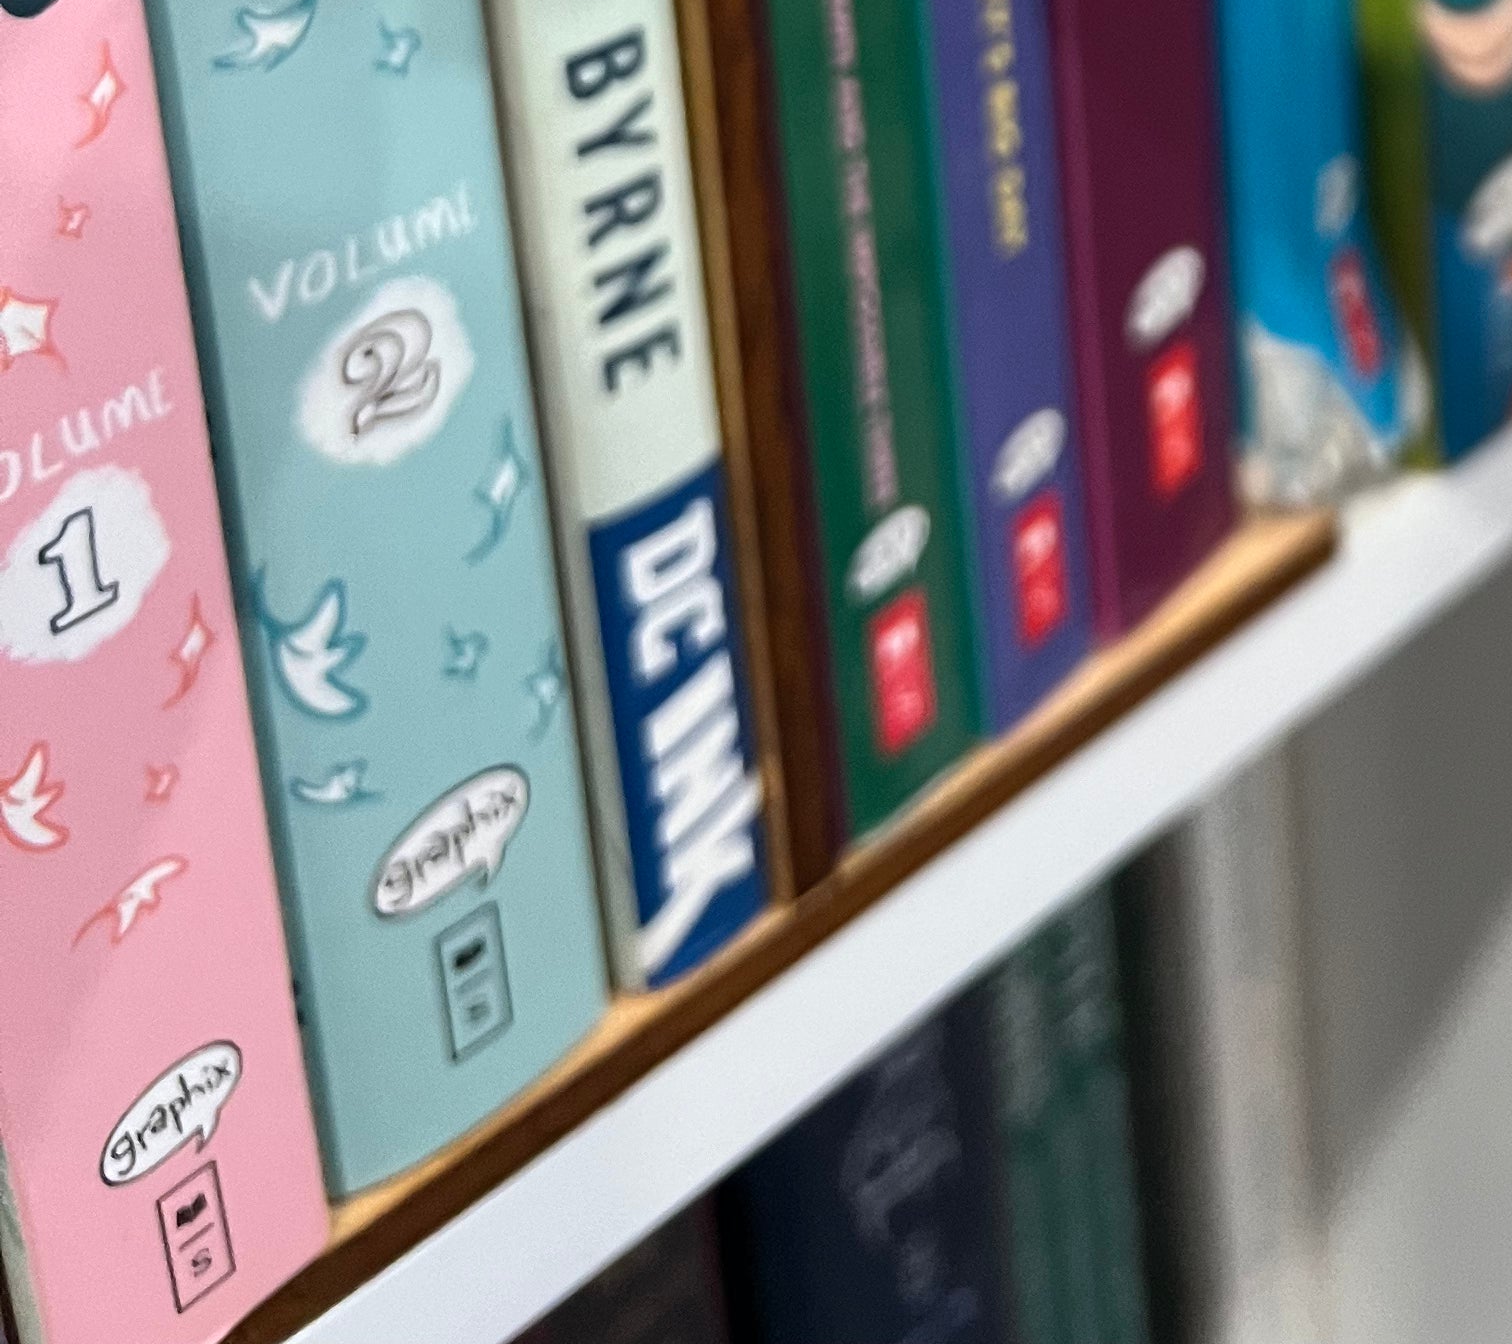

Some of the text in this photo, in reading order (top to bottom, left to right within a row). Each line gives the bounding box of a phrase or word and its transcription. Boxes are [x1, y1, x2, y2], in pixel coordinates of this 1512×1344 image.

[564, 28, 682, 394] BYRNE
[342, 308, 441, 436] 2
[38, 506, 120, 636] 1
[622, 494, 766, 976] DC INK
[384, 780, 519, 910] graphix
[110, 1060, 231, 1177] graphix
